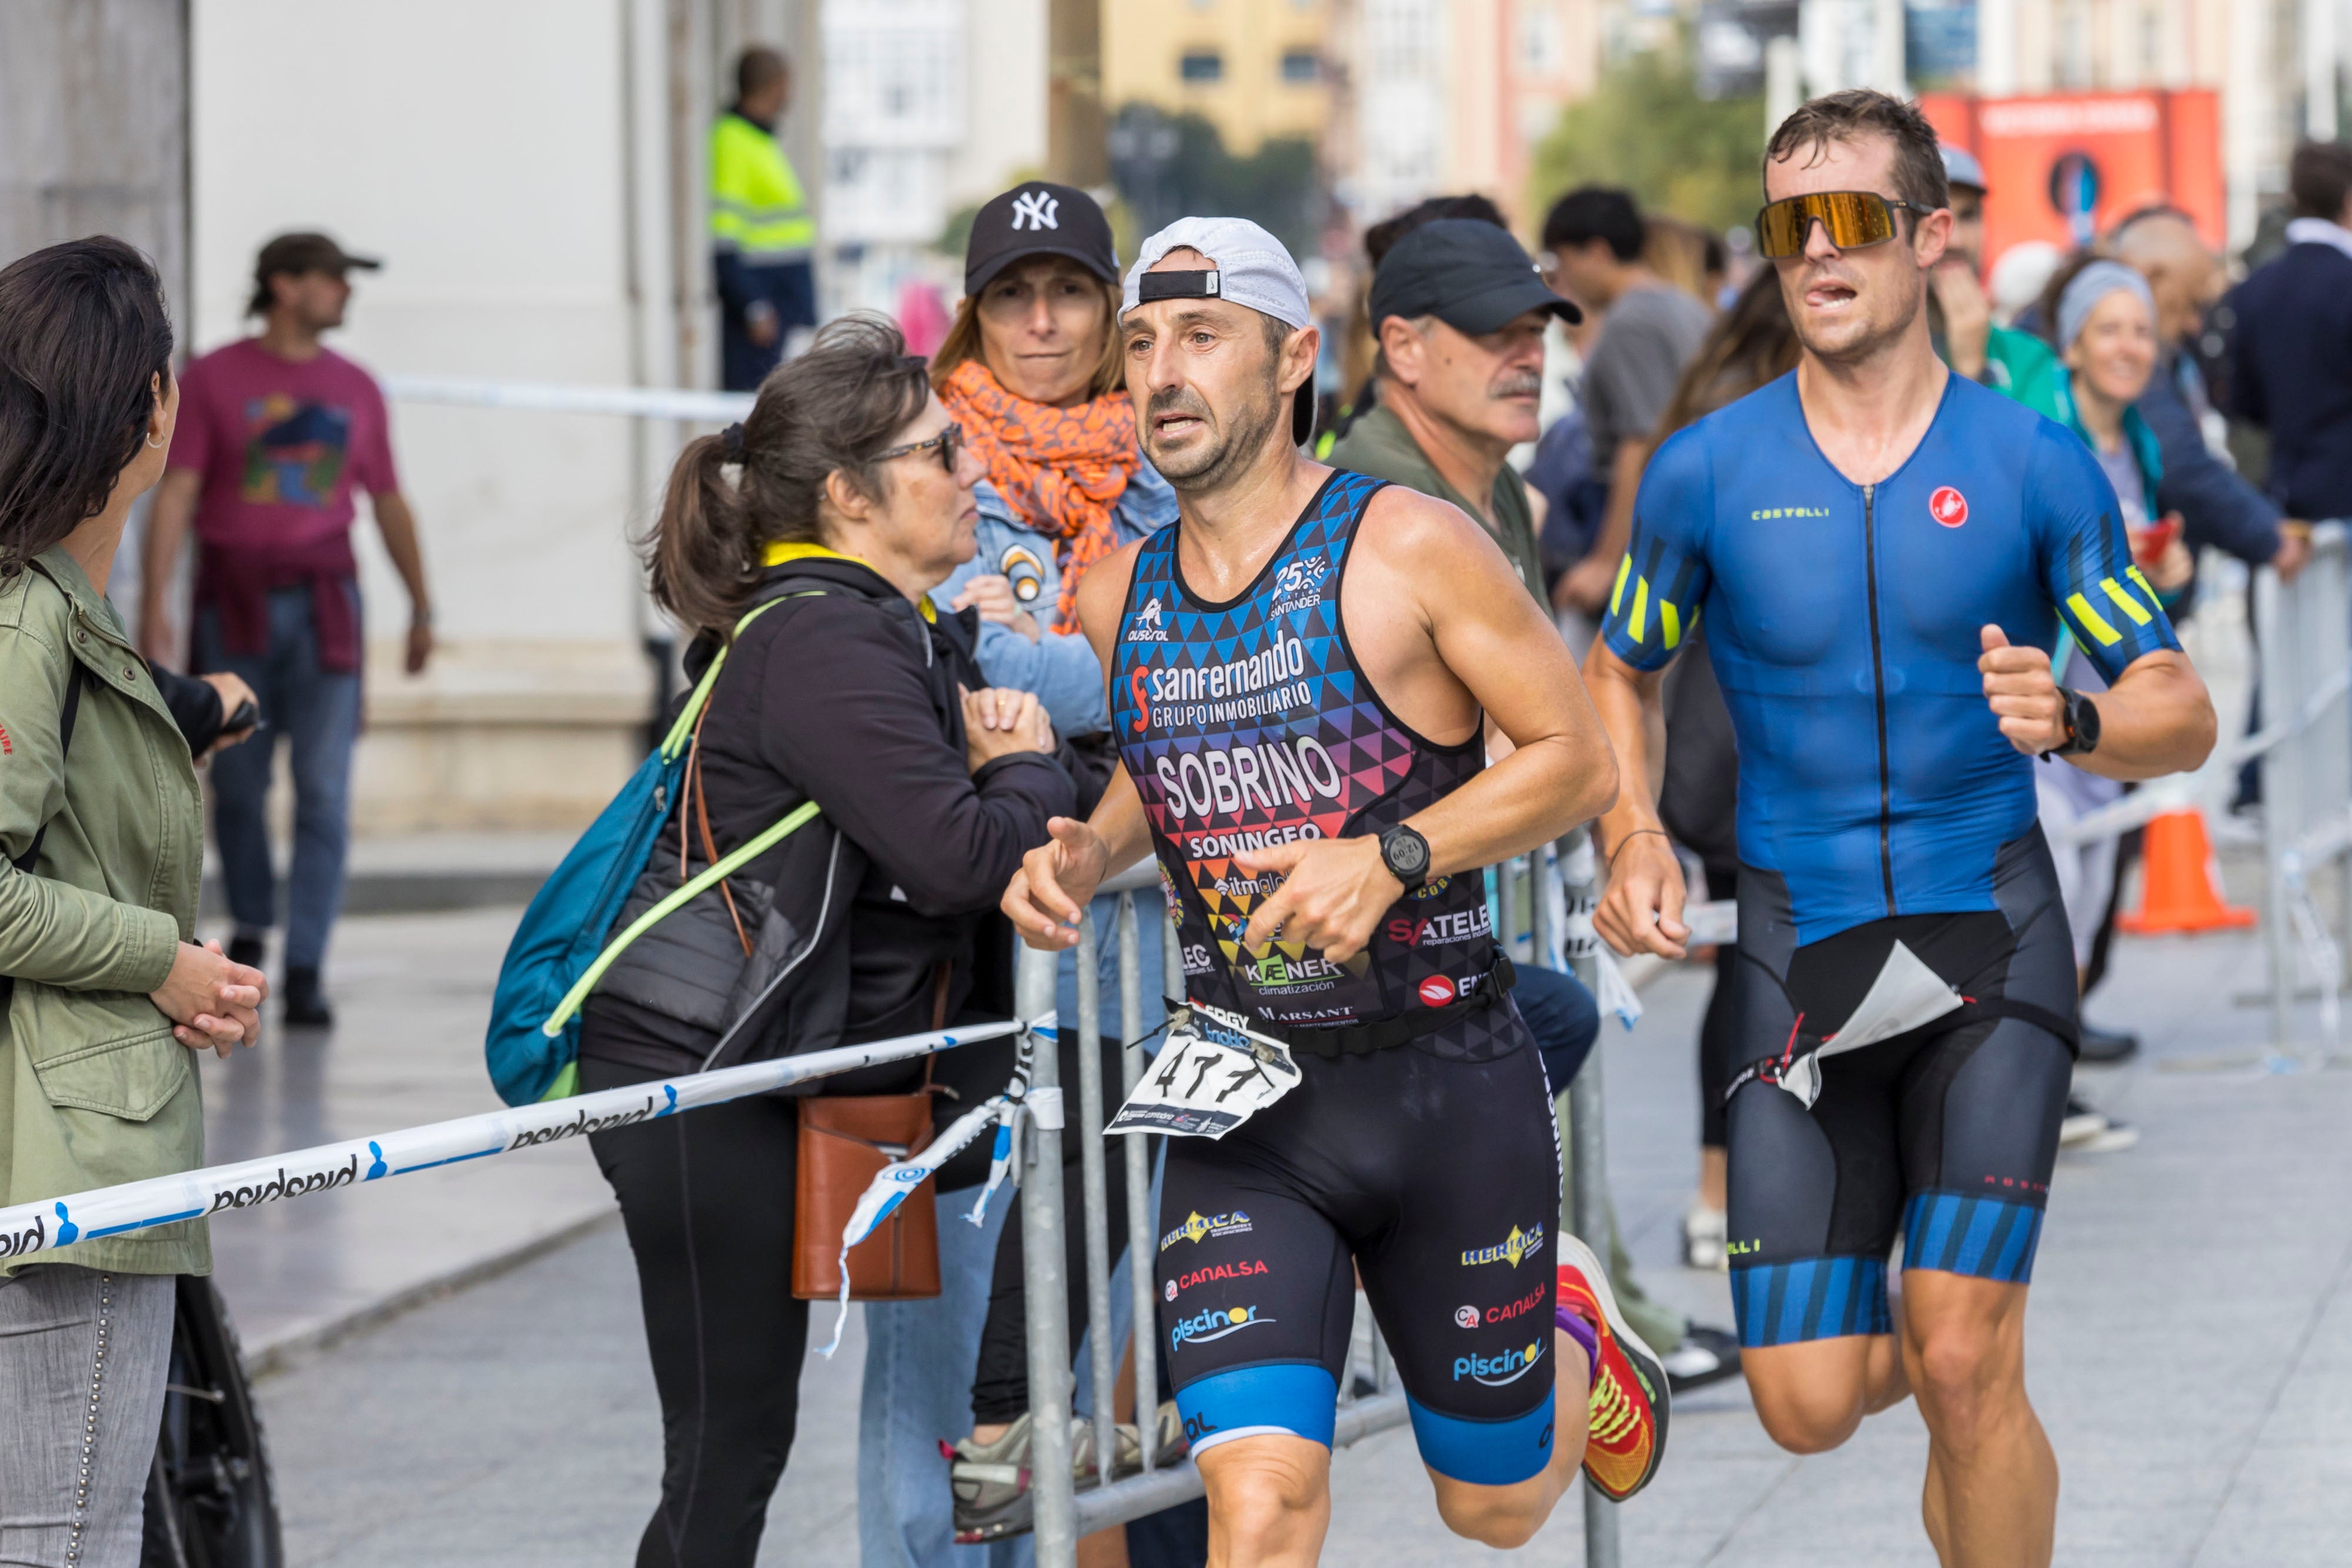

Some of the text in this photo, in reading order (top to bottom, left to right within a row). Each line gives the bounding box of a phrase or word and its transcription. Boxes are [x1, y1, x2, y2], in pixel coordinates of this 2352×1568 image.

[1012, 190, 1059, 231] NY
[1270, 594, 1321, 621] SANTANDER
[1152, 681, 1312, 728] GRUPO INMOBILIARIO
[1157, 735, 1341, 819] SOBRINO
[1258, 980, 1335, 996] climatización
[1154, 1042, 1261, 1103] 477
[1180, 1260, 1269, 1289] CANALSA
[1486, 1282, 1546, 1323] CANALSA
